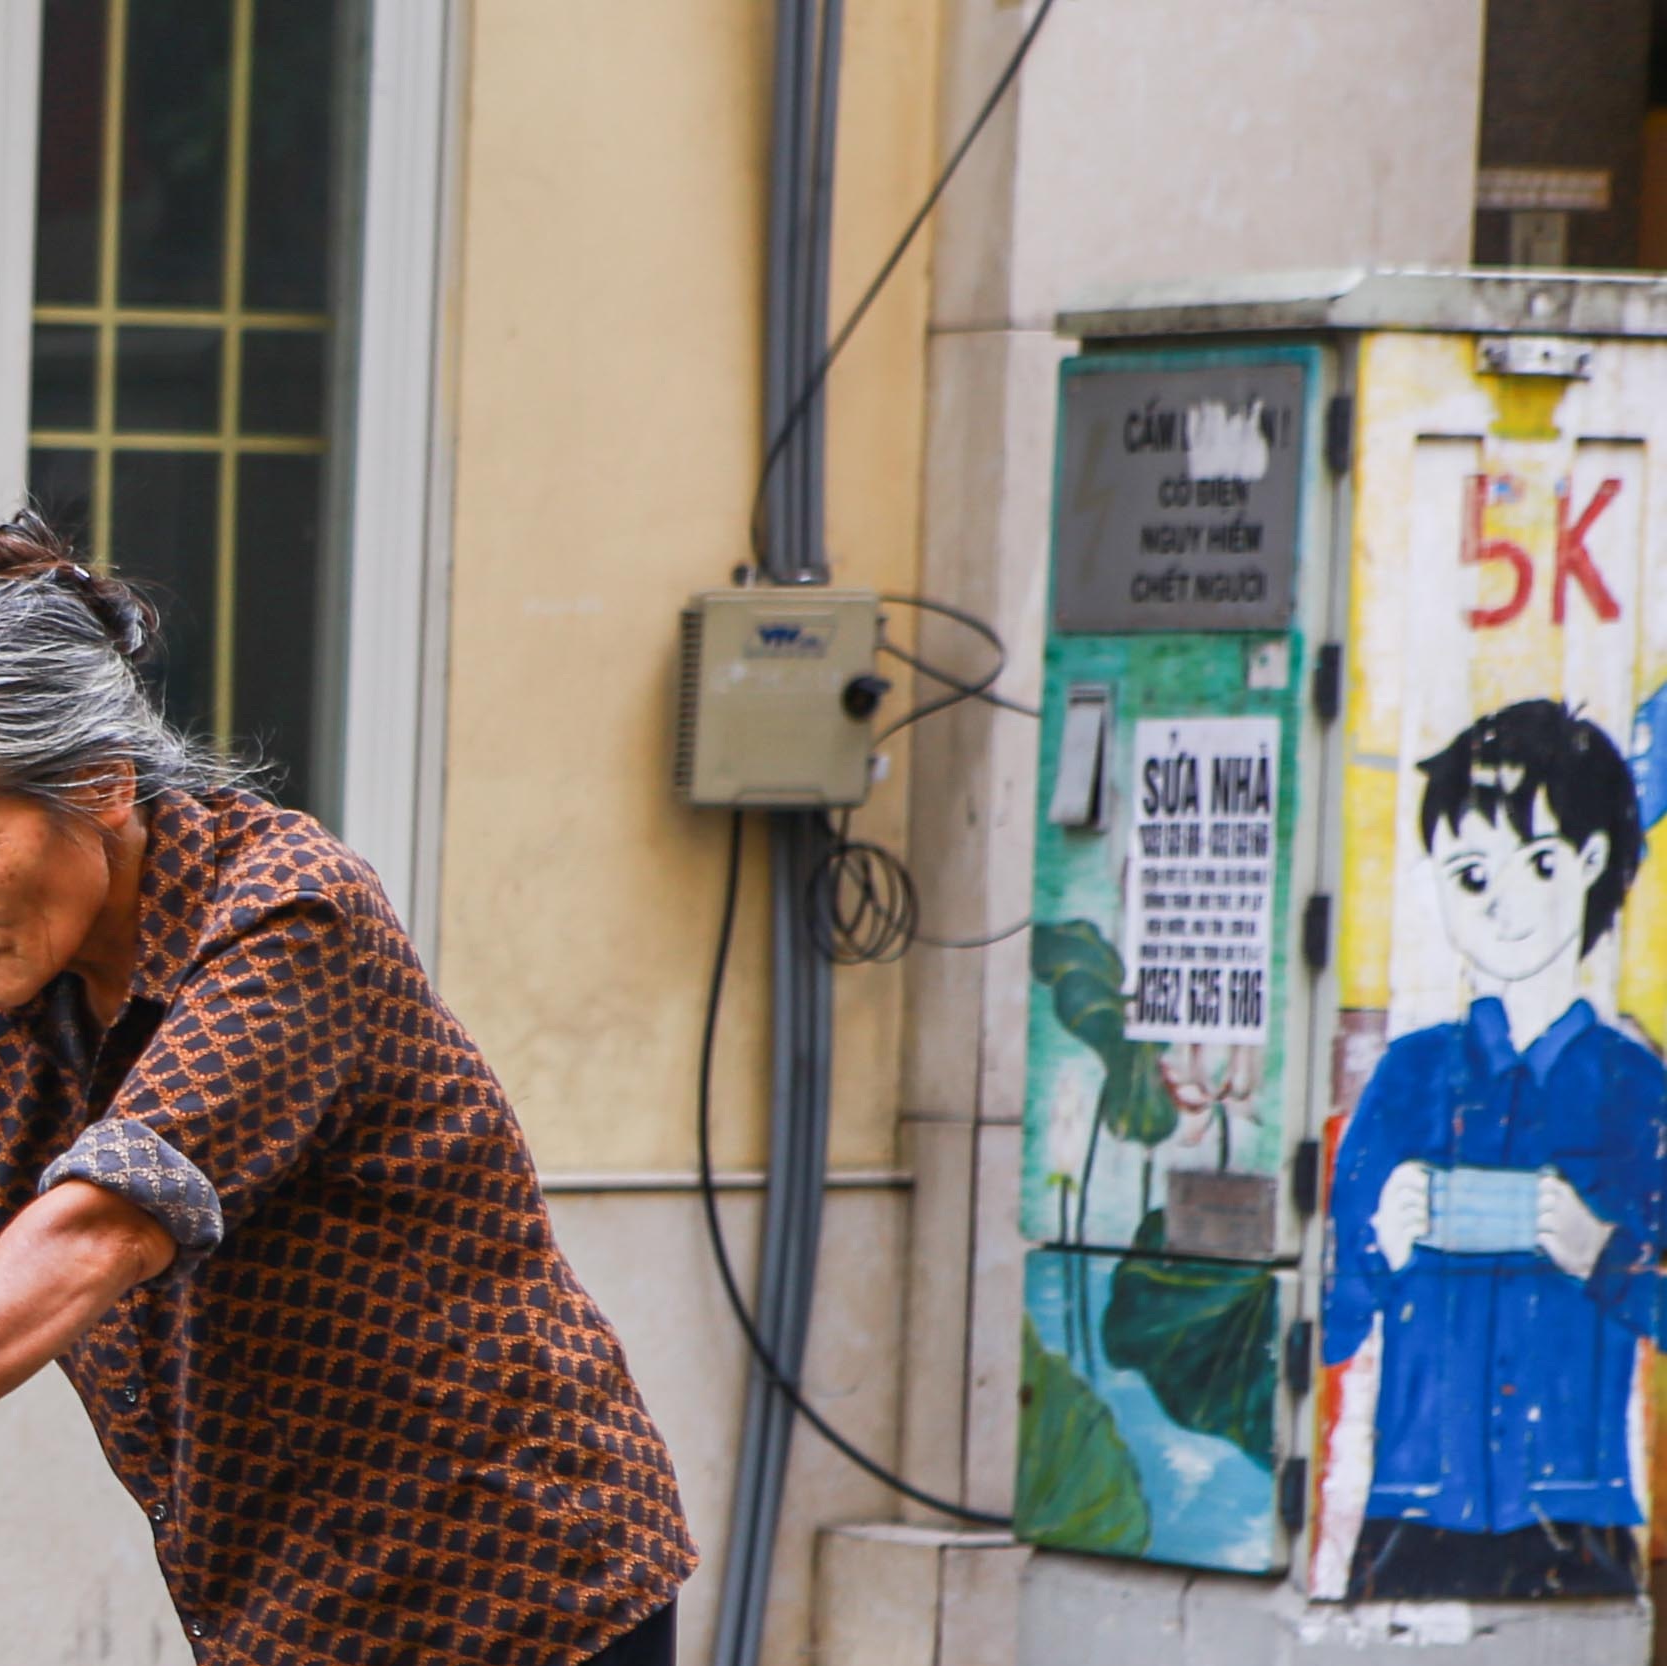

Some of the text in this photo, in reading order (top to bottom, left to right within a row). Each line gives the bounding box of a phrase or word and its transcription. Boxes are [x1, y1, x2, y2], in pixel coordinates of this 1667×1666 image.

[1140, 524, 1201, 554] NGUY
[1463, 473, 1622, 630] 5K
[1143, 731, 1199, 816] SỬA
